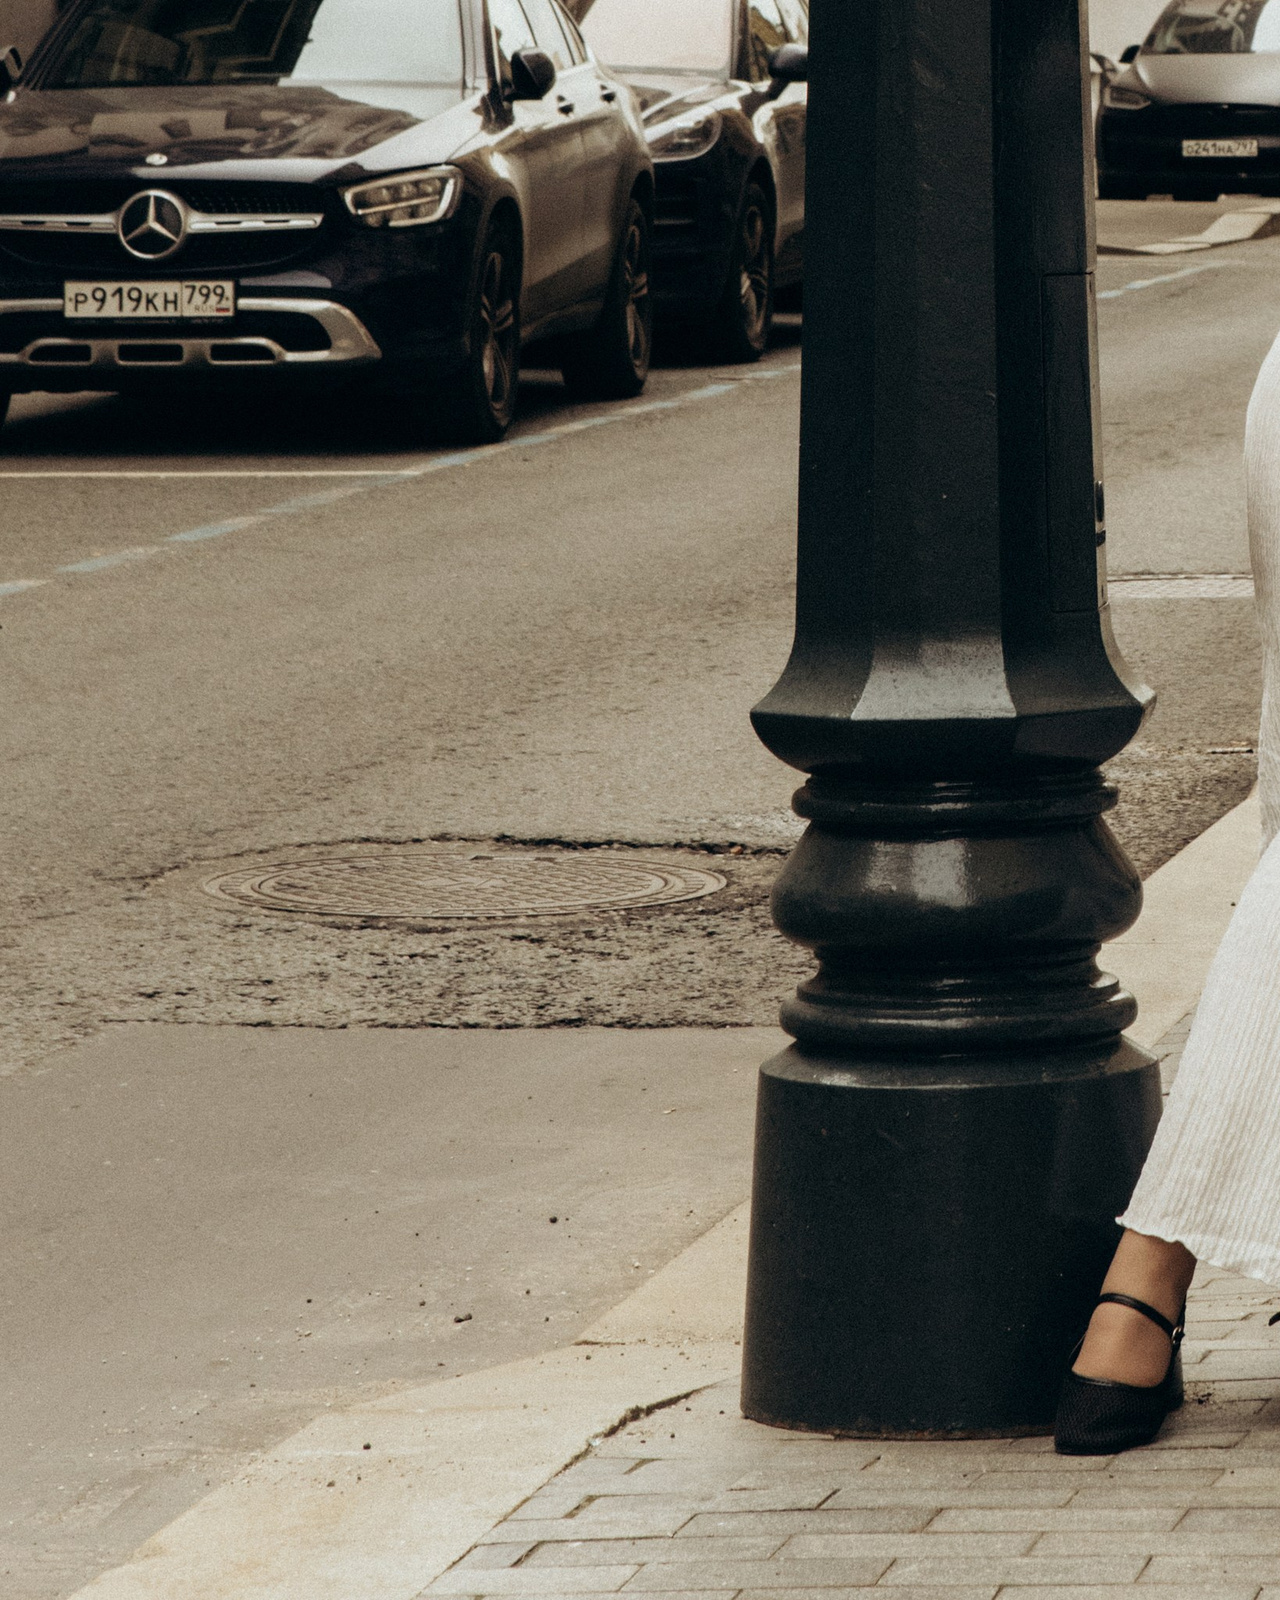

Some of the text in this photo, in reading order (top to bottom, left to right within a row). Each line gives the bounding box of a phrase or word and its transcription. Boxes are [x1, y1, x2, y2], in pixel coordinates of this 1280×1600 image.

[74, 285, 225, 313] Р919КН 799
[194, 305, 214, 314] RUS
